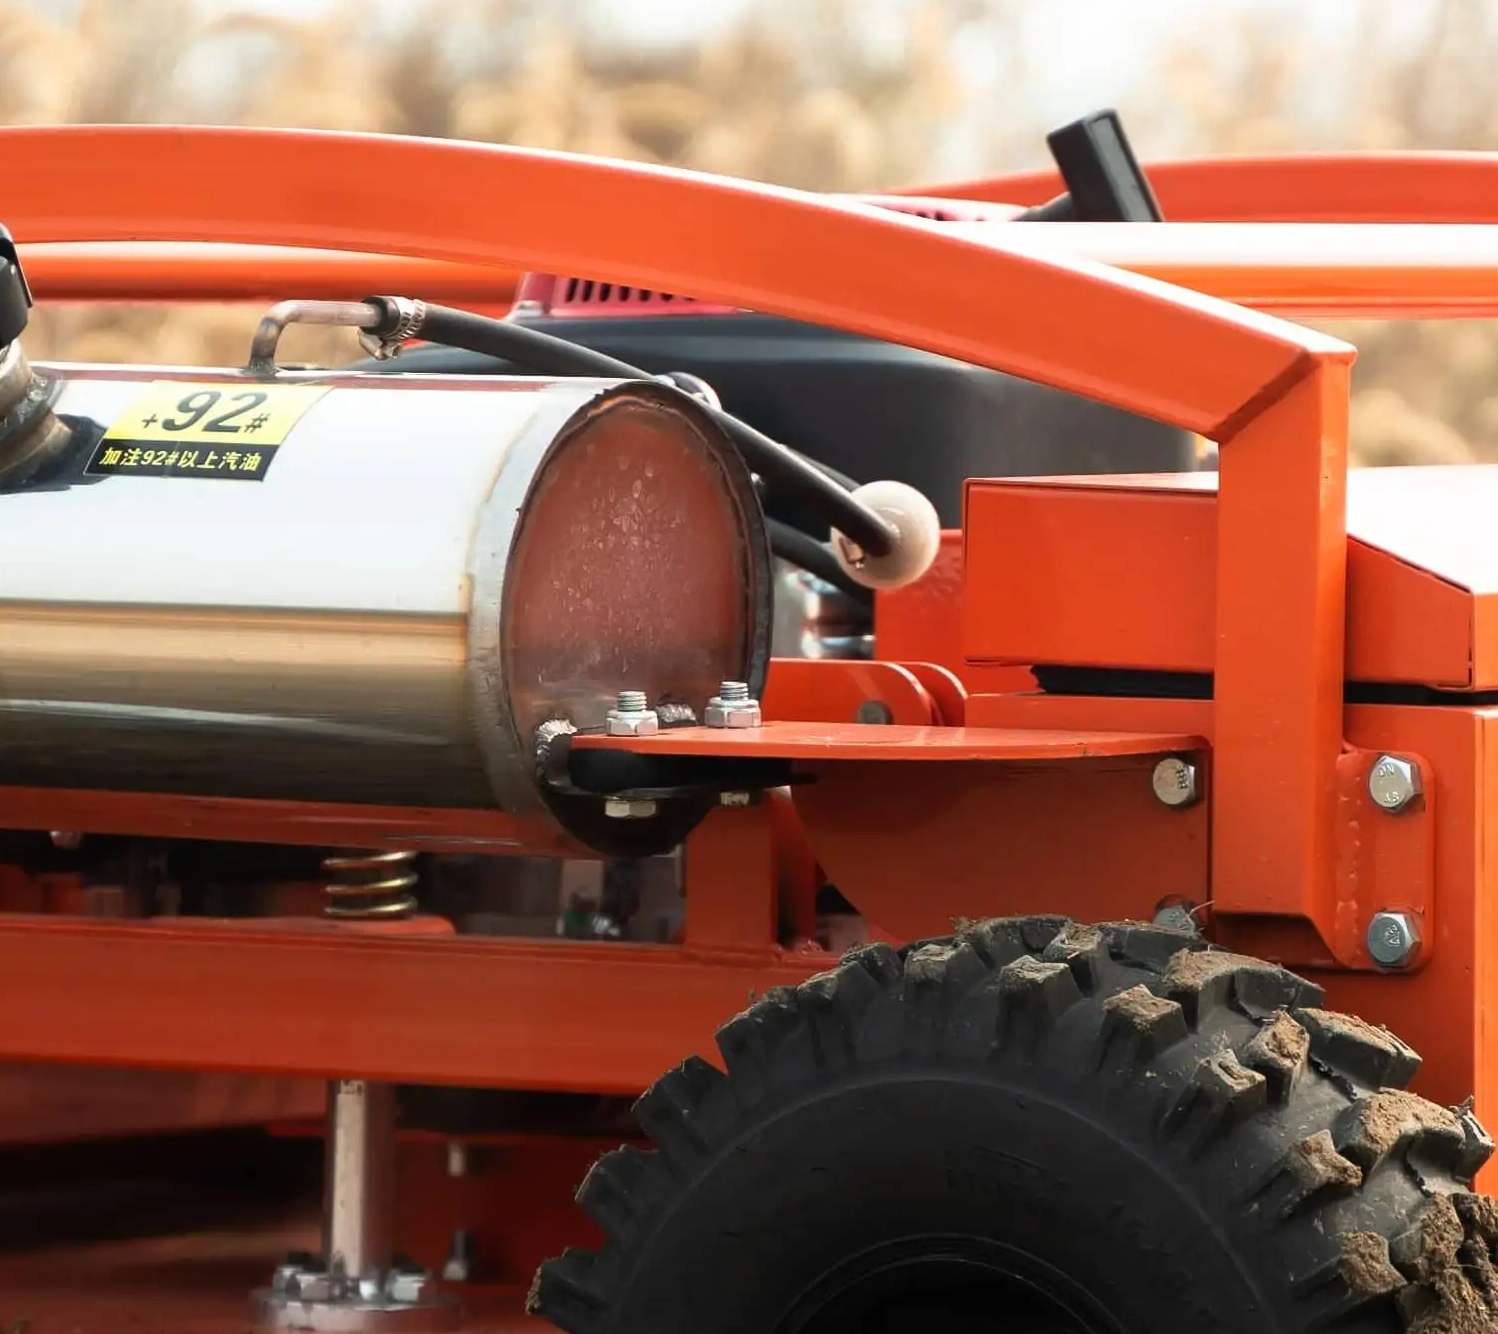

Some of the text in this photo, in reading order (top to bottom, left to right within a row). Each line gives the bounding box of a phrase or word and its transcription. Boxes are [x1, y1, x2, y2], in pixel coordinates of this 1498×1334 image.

[99, 447, 262, 471] 加注92#以上汽油
